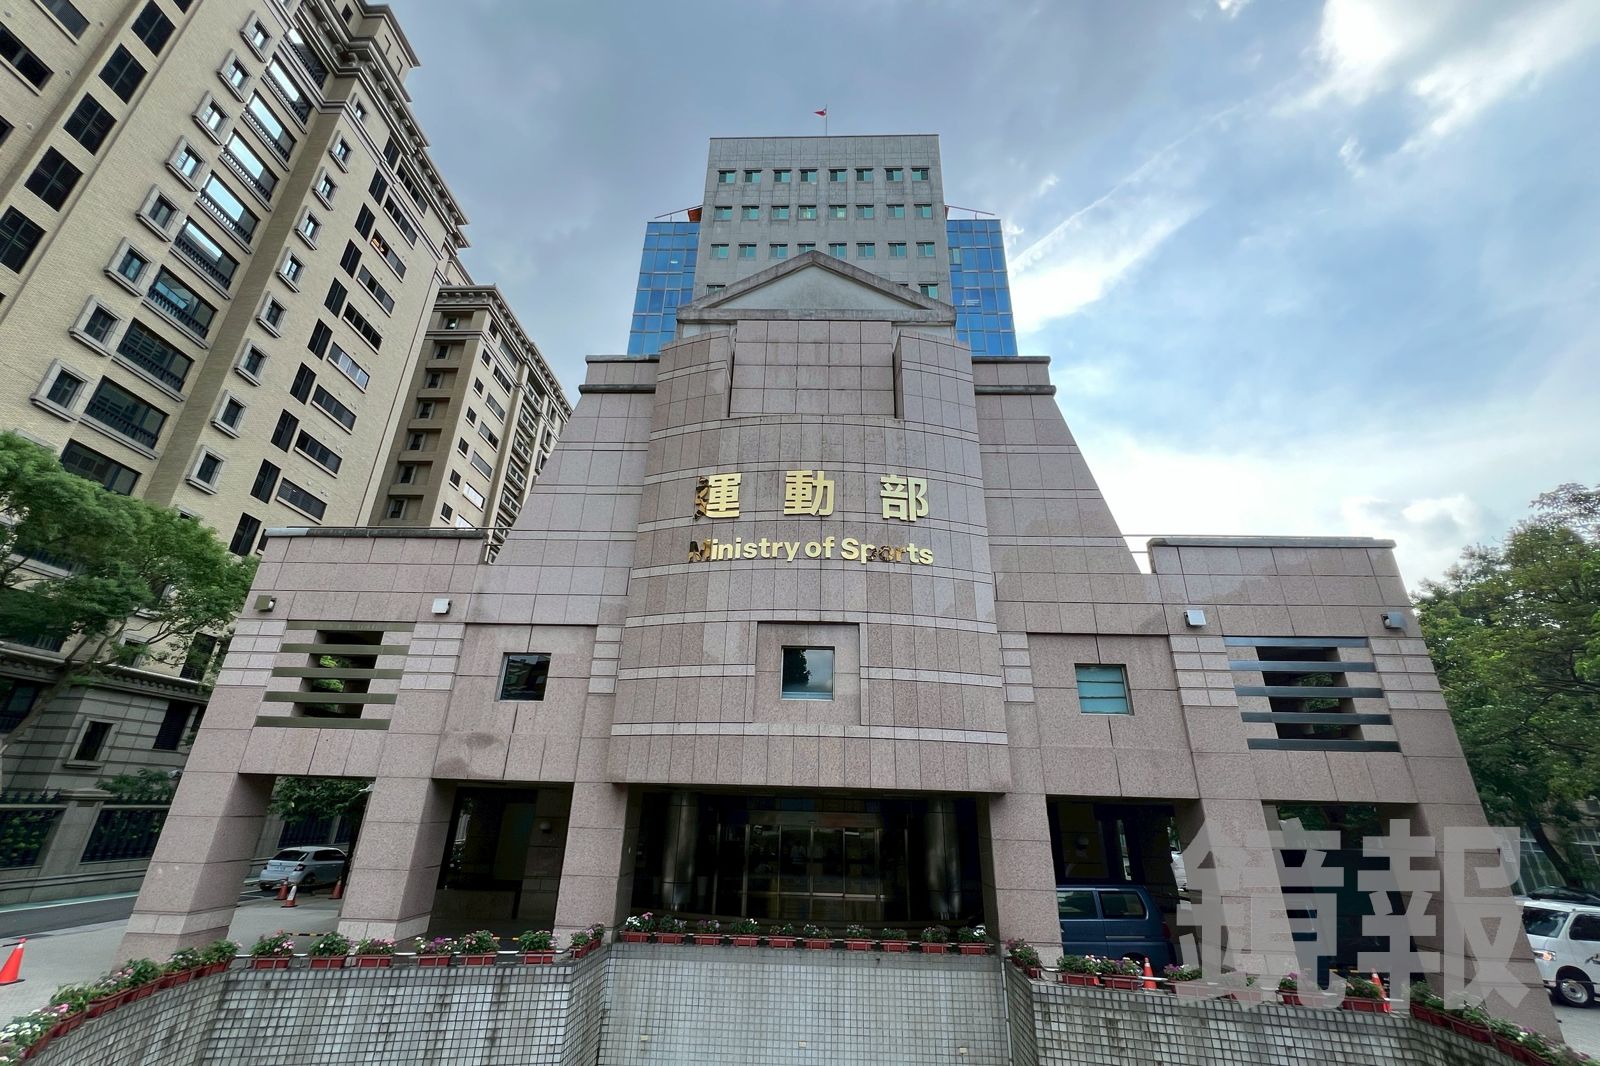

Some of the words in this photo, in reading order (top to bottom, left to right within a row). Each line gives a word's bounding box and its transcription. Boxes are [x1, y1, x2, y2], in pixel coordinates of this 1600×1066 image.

[694, 470, 928, 522] 運動部
[688, 537, 800, 562] Ministry
[804, 536, 835, 558] of
[840, 537, 934, 565] Sports
